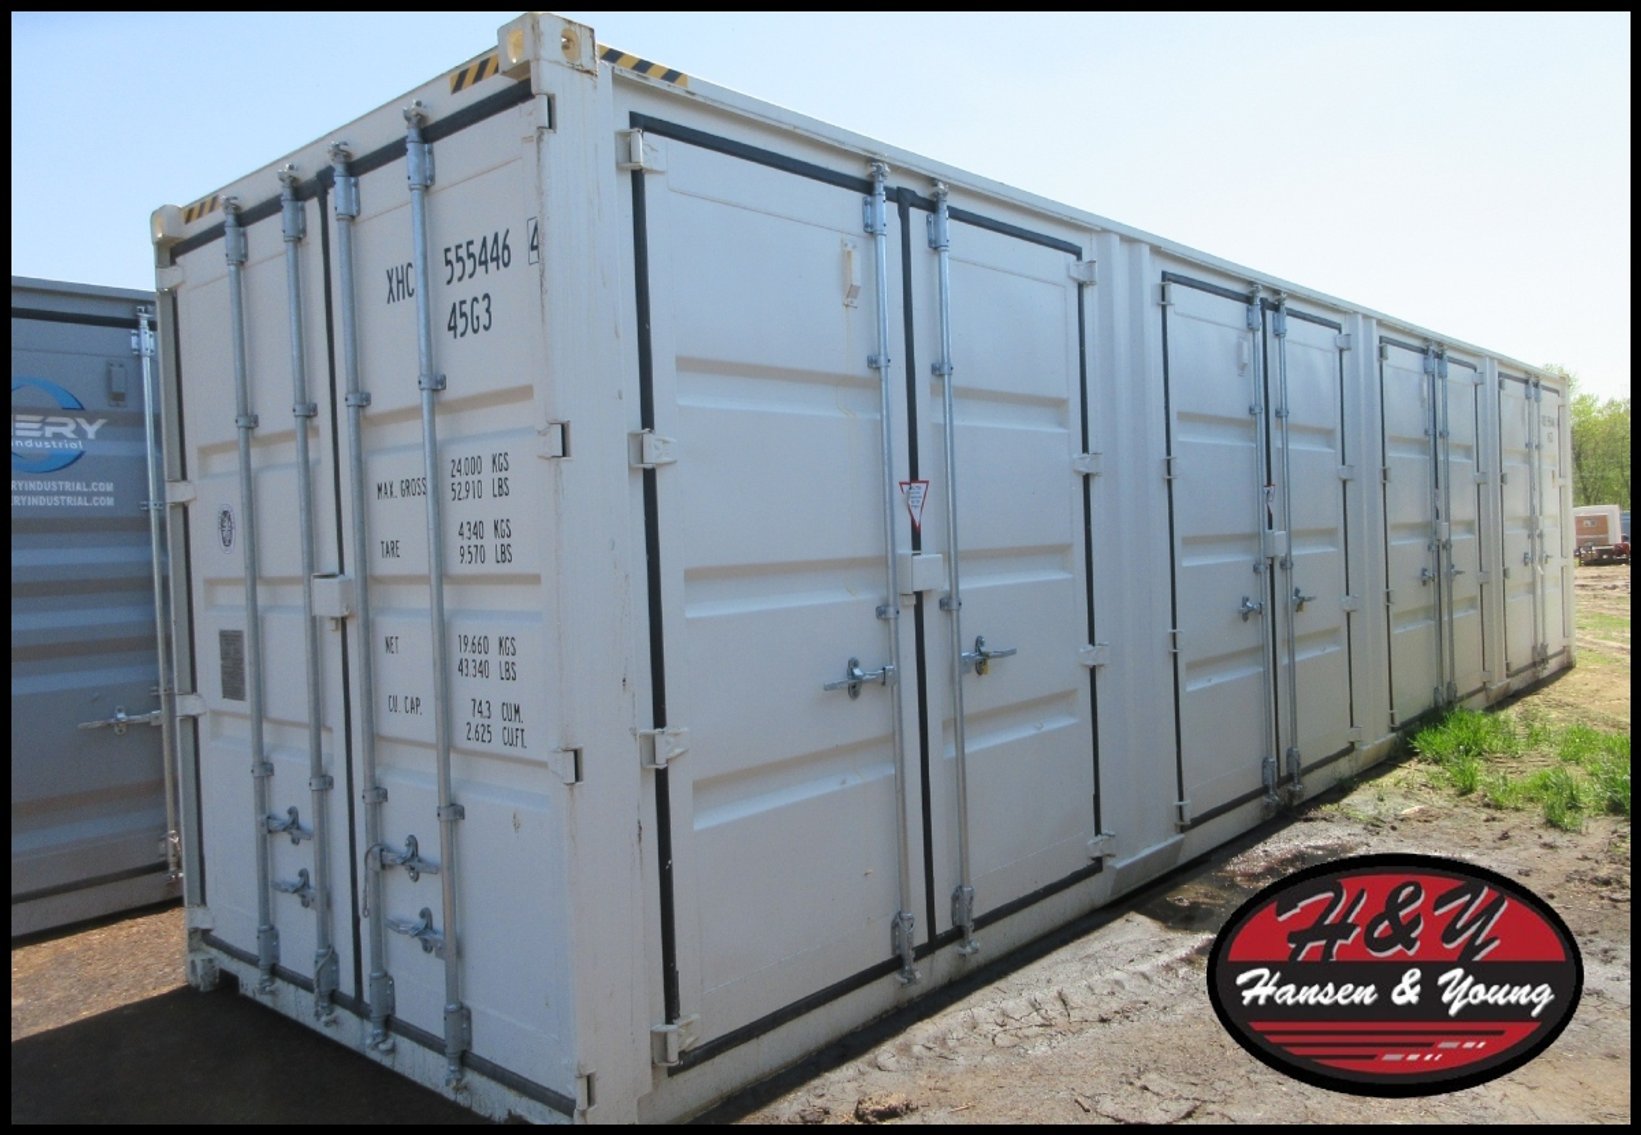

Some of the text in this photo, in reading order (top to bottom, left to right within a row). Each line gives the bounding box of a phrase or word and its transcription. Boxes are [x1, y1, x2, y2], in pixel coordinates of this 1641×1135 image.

[443, 228, 512, 286] 555446
[447, 292, 493, 340] 45G3
[450, 452, 510, 478] 24.000 KGS
[400, 477, 427, 498] GROSS
[451, 477, 511, 502] 52.910 LBS
[493, 518, 512, 540] KGS
[380, 540, 401, 559] TARE
[459, 543, 513, 565] 9.570 LBS
[384, 635, 400, 654] NET
[458, 634, 518, 657] 19.660 KGS
[499, 660, 517, 681] LBS
[404, 696, 423, 717] CAP.
